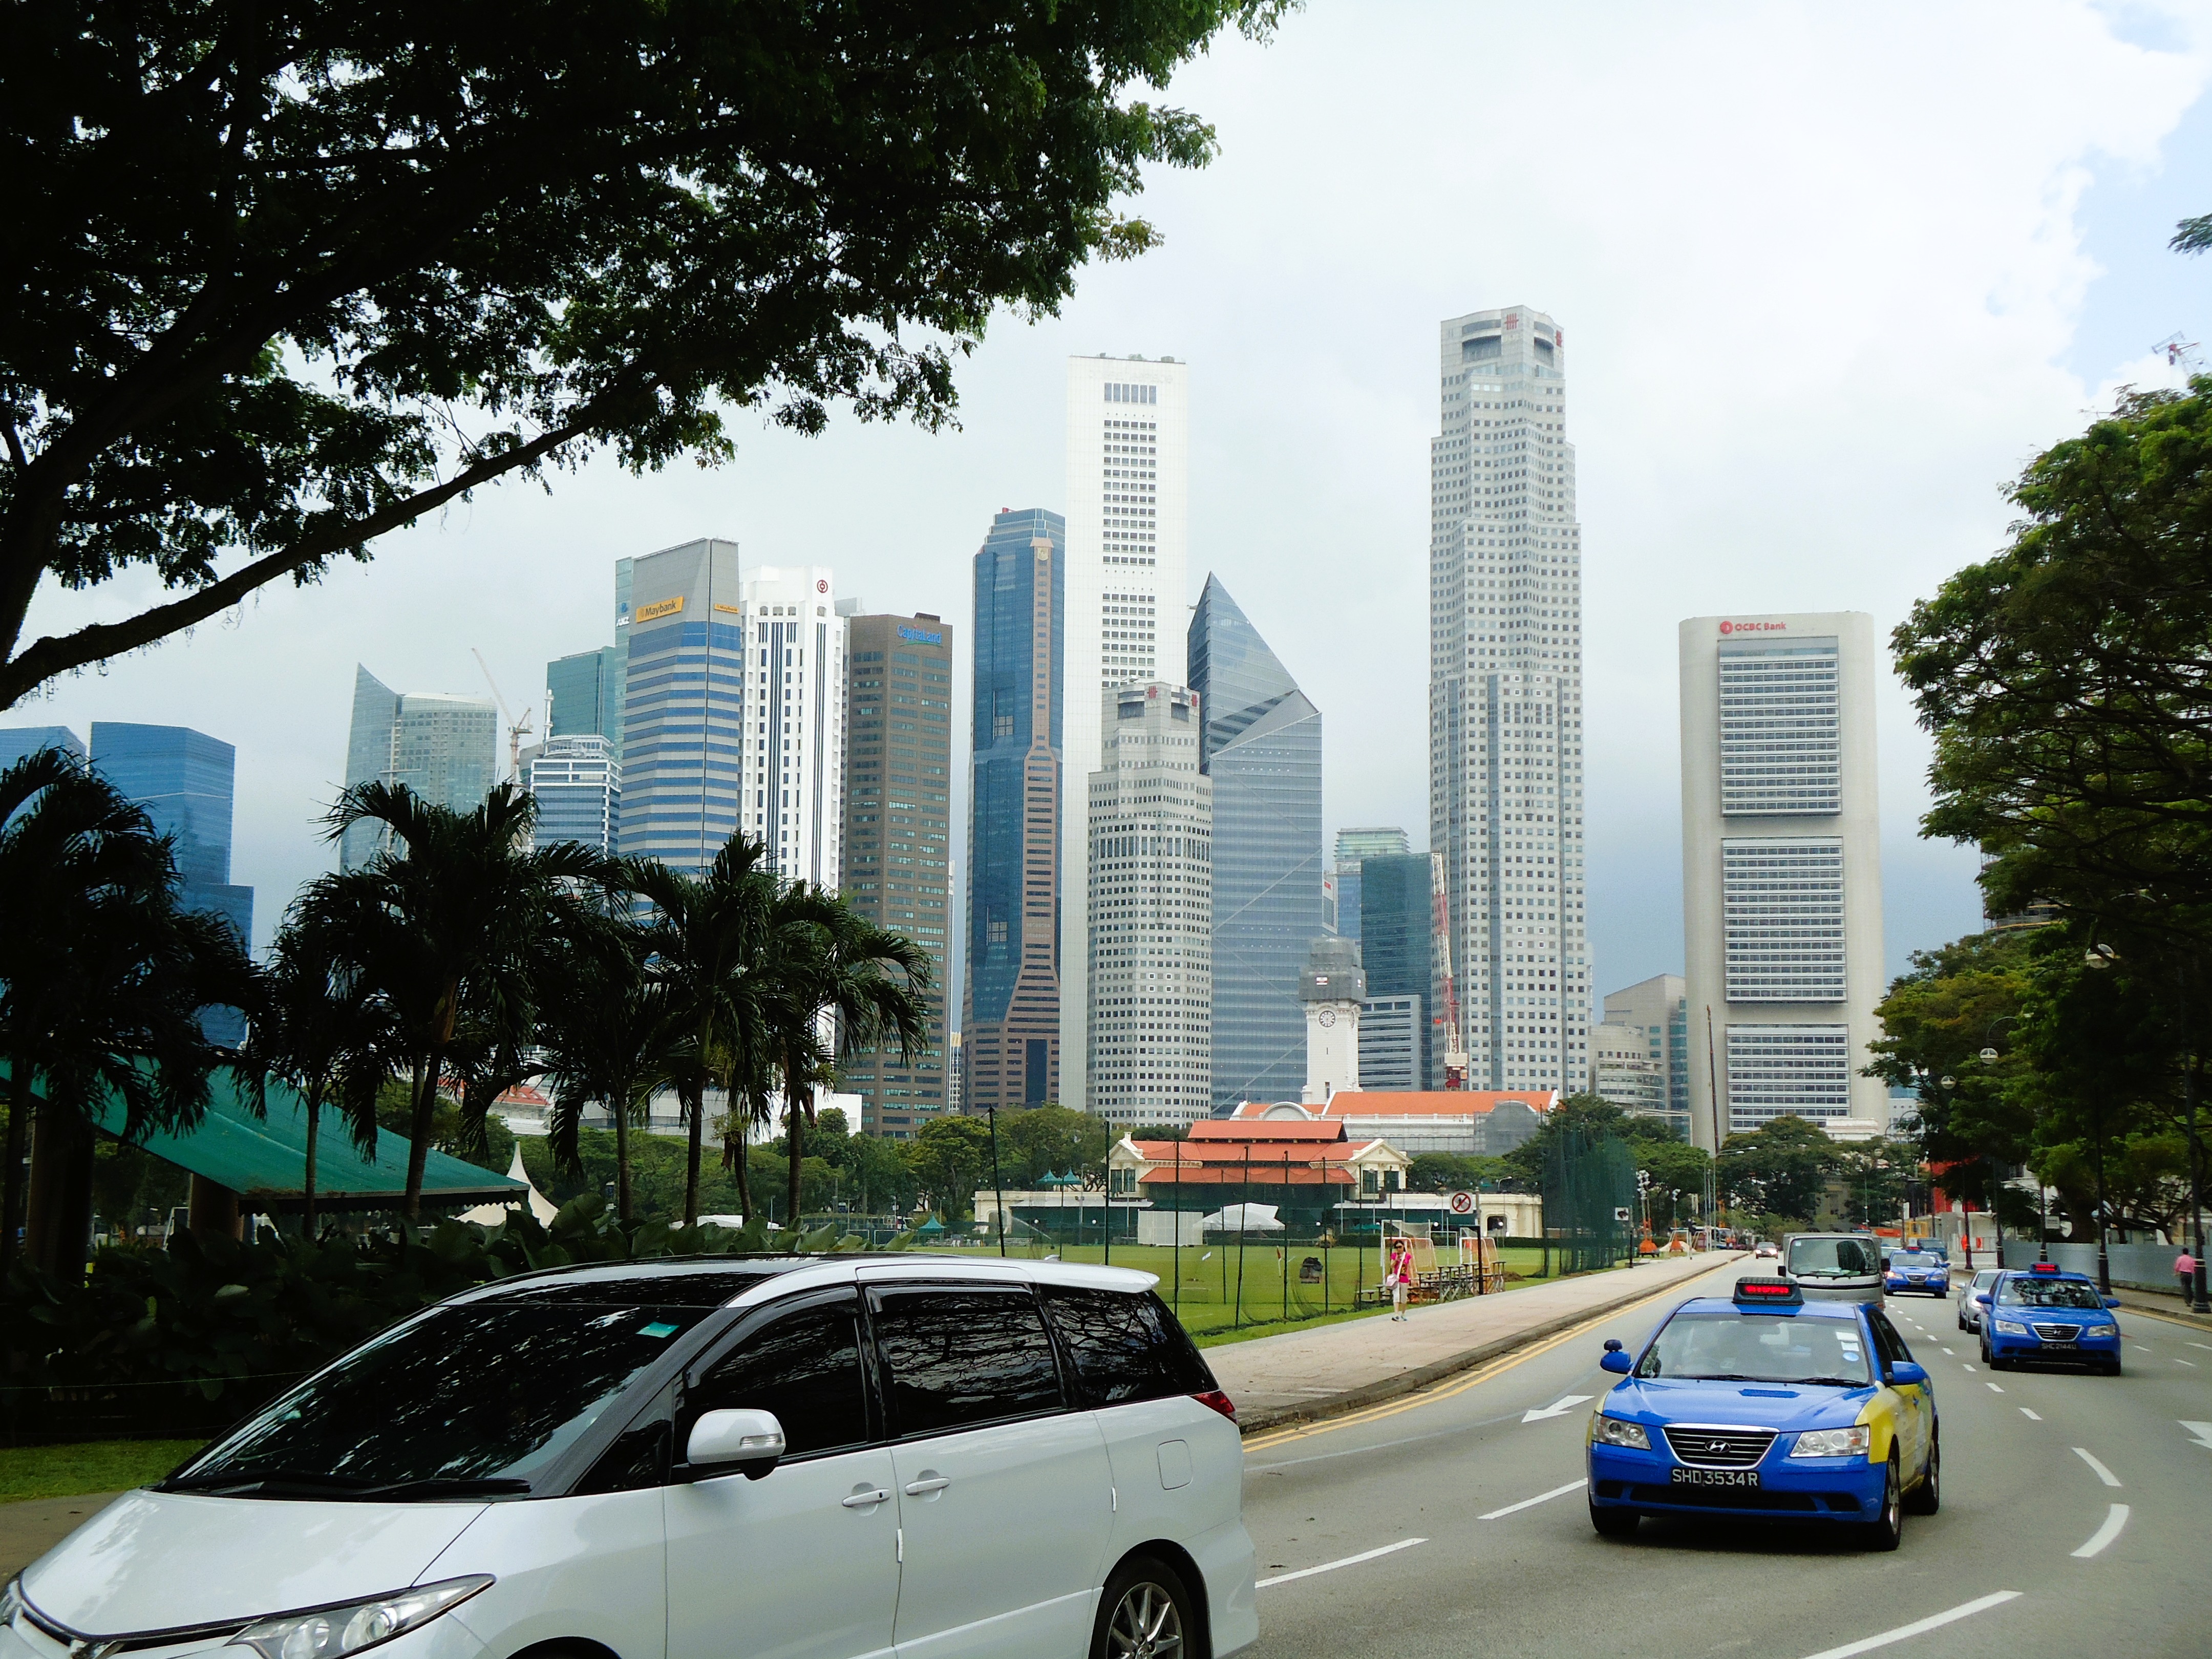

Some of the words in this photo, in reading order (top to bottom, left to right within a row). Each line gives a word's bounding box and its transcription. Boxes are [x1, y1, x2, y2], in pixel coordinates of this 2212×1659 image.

[645, 600, 676, 616] Maybank
[1764, 621, 1786, 630] Bank
[897, 624, 942, 644] CapitaLand
